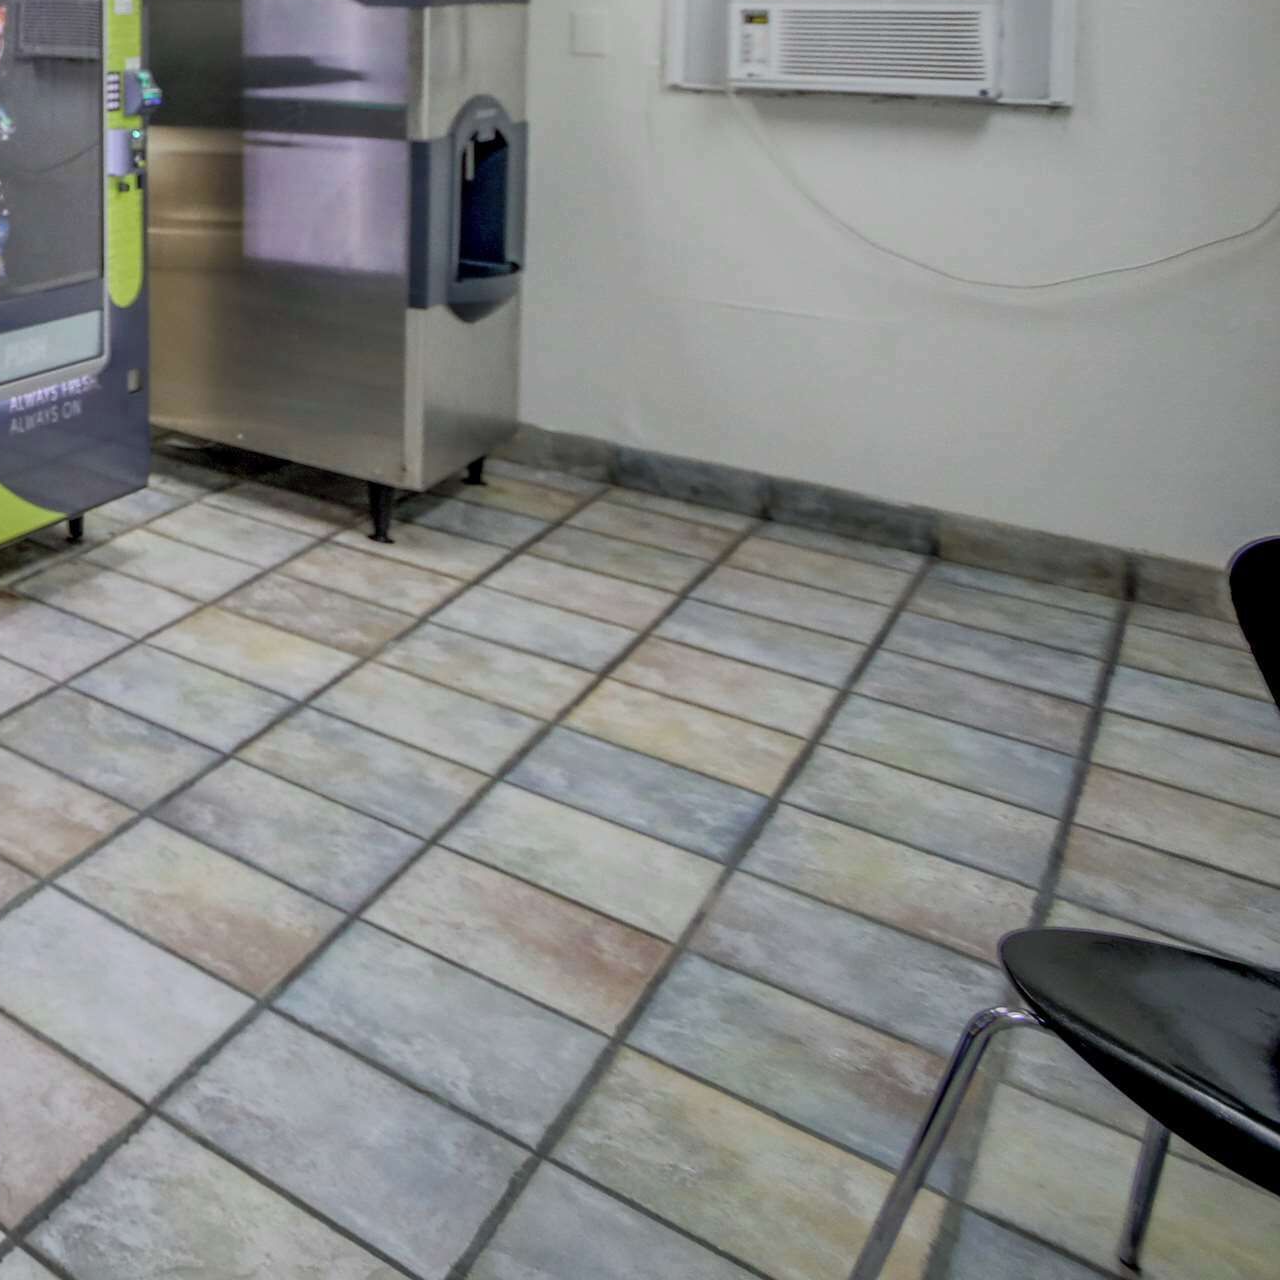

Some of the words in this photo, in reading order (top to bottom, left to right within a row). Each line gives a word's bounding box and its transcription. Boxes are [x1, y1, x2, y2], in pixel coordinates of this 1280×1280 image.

[9, 384, 58, 413] ALWAYS
[9, 405, 59, 435] ALWAYS
[61, 400, 82, 419] ON
